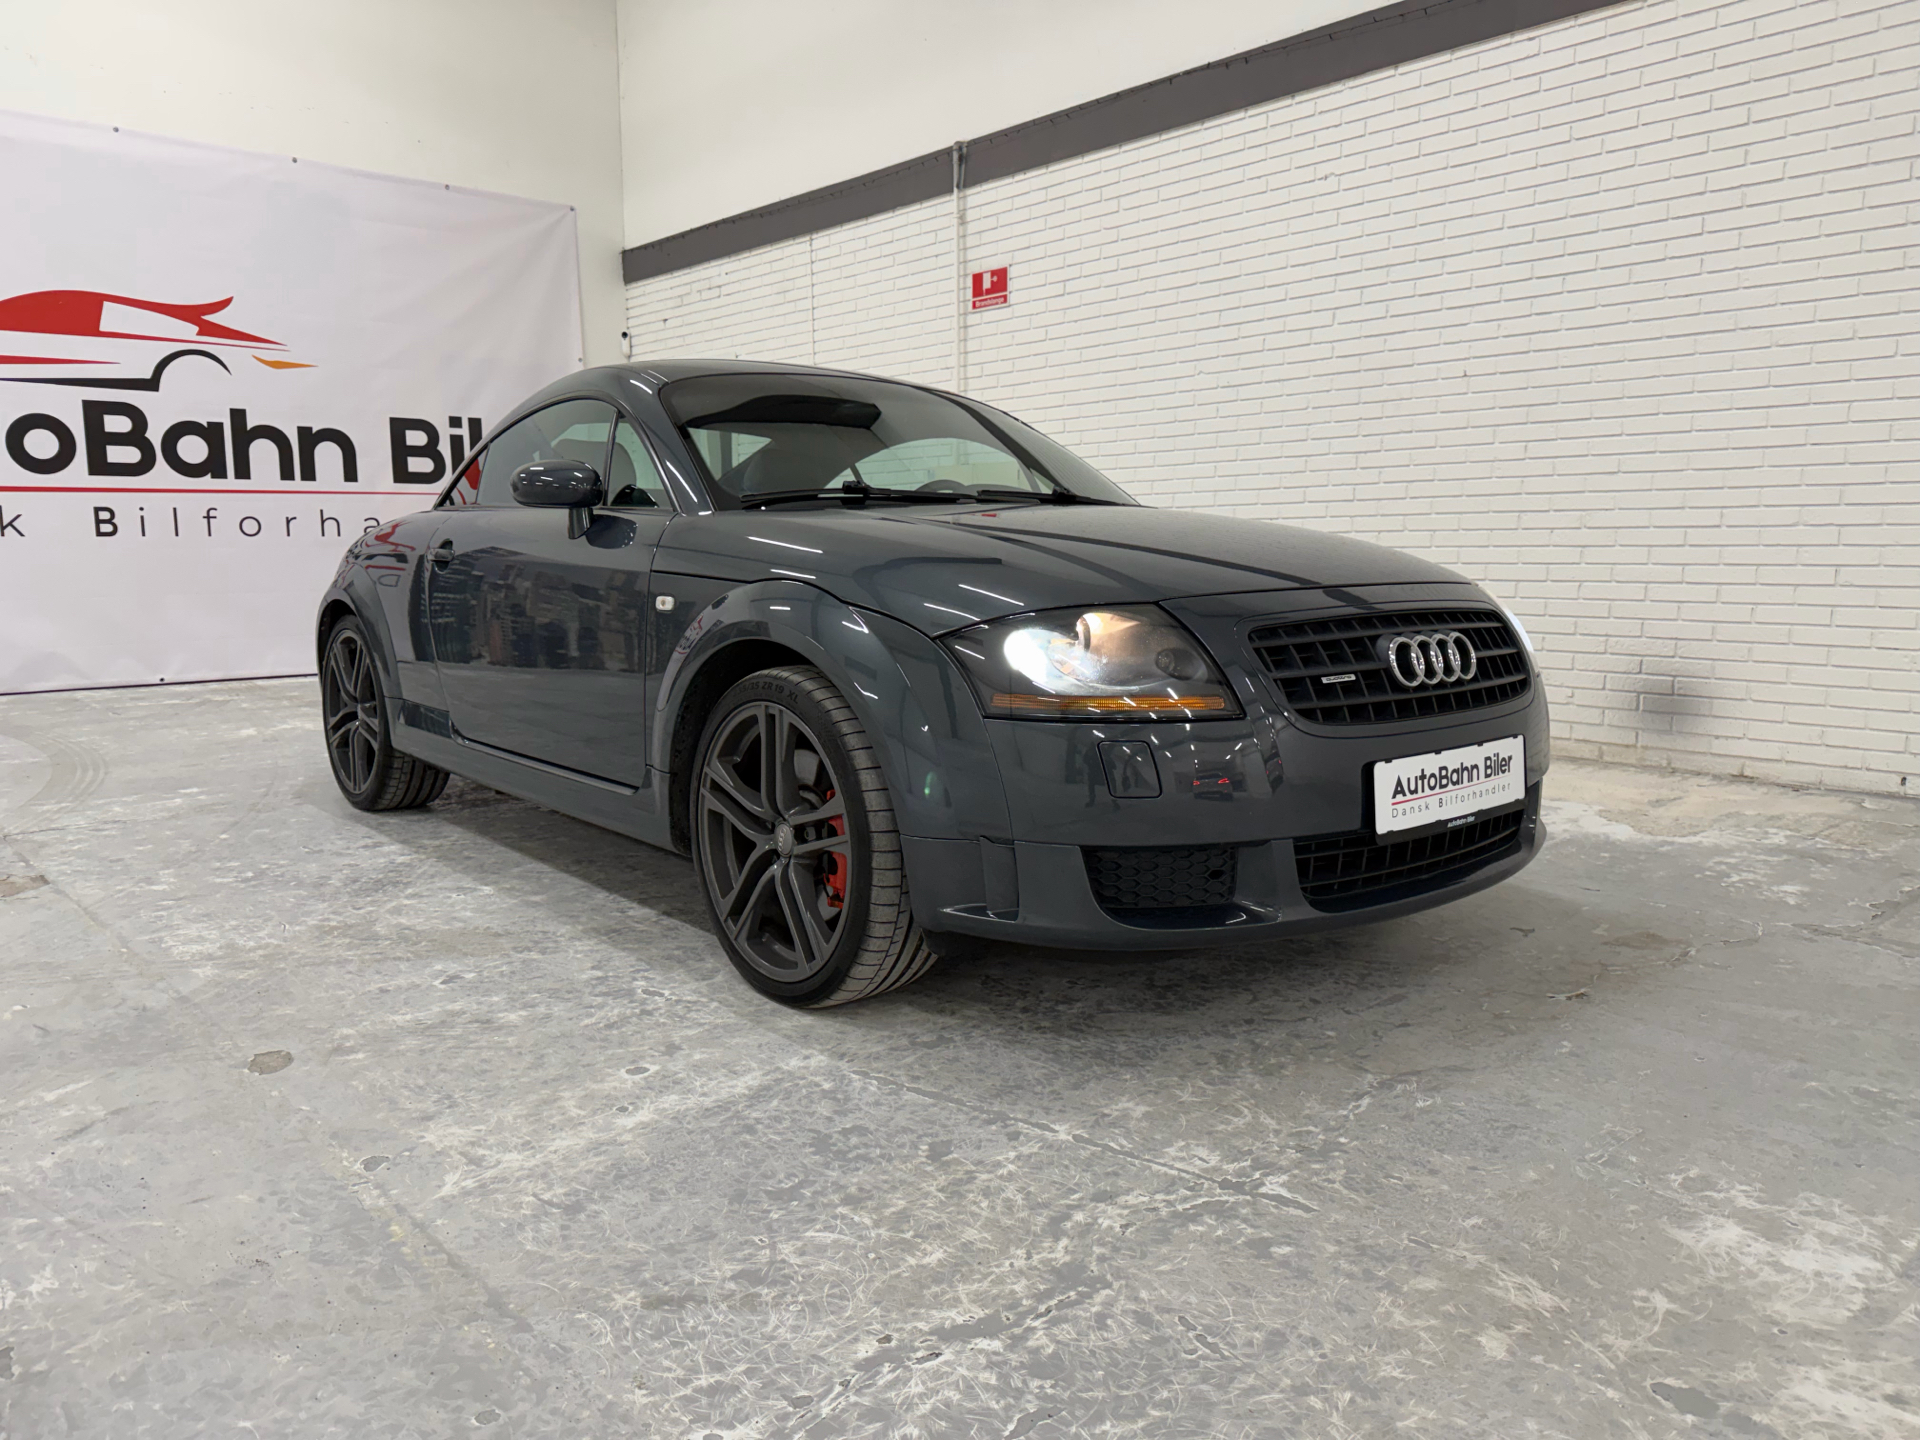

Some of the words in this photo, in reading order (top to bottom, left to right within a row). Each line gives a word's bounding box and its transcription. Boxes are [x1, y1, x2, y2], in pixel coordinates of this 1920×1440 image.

[1391, 761, 1480, 800] AutoBahn
[1484, 752, 1513, 779] Biler
[1391, 802, 1430, 819] Dansk
[1438, 781, 1511, 808] Bilforhandler
